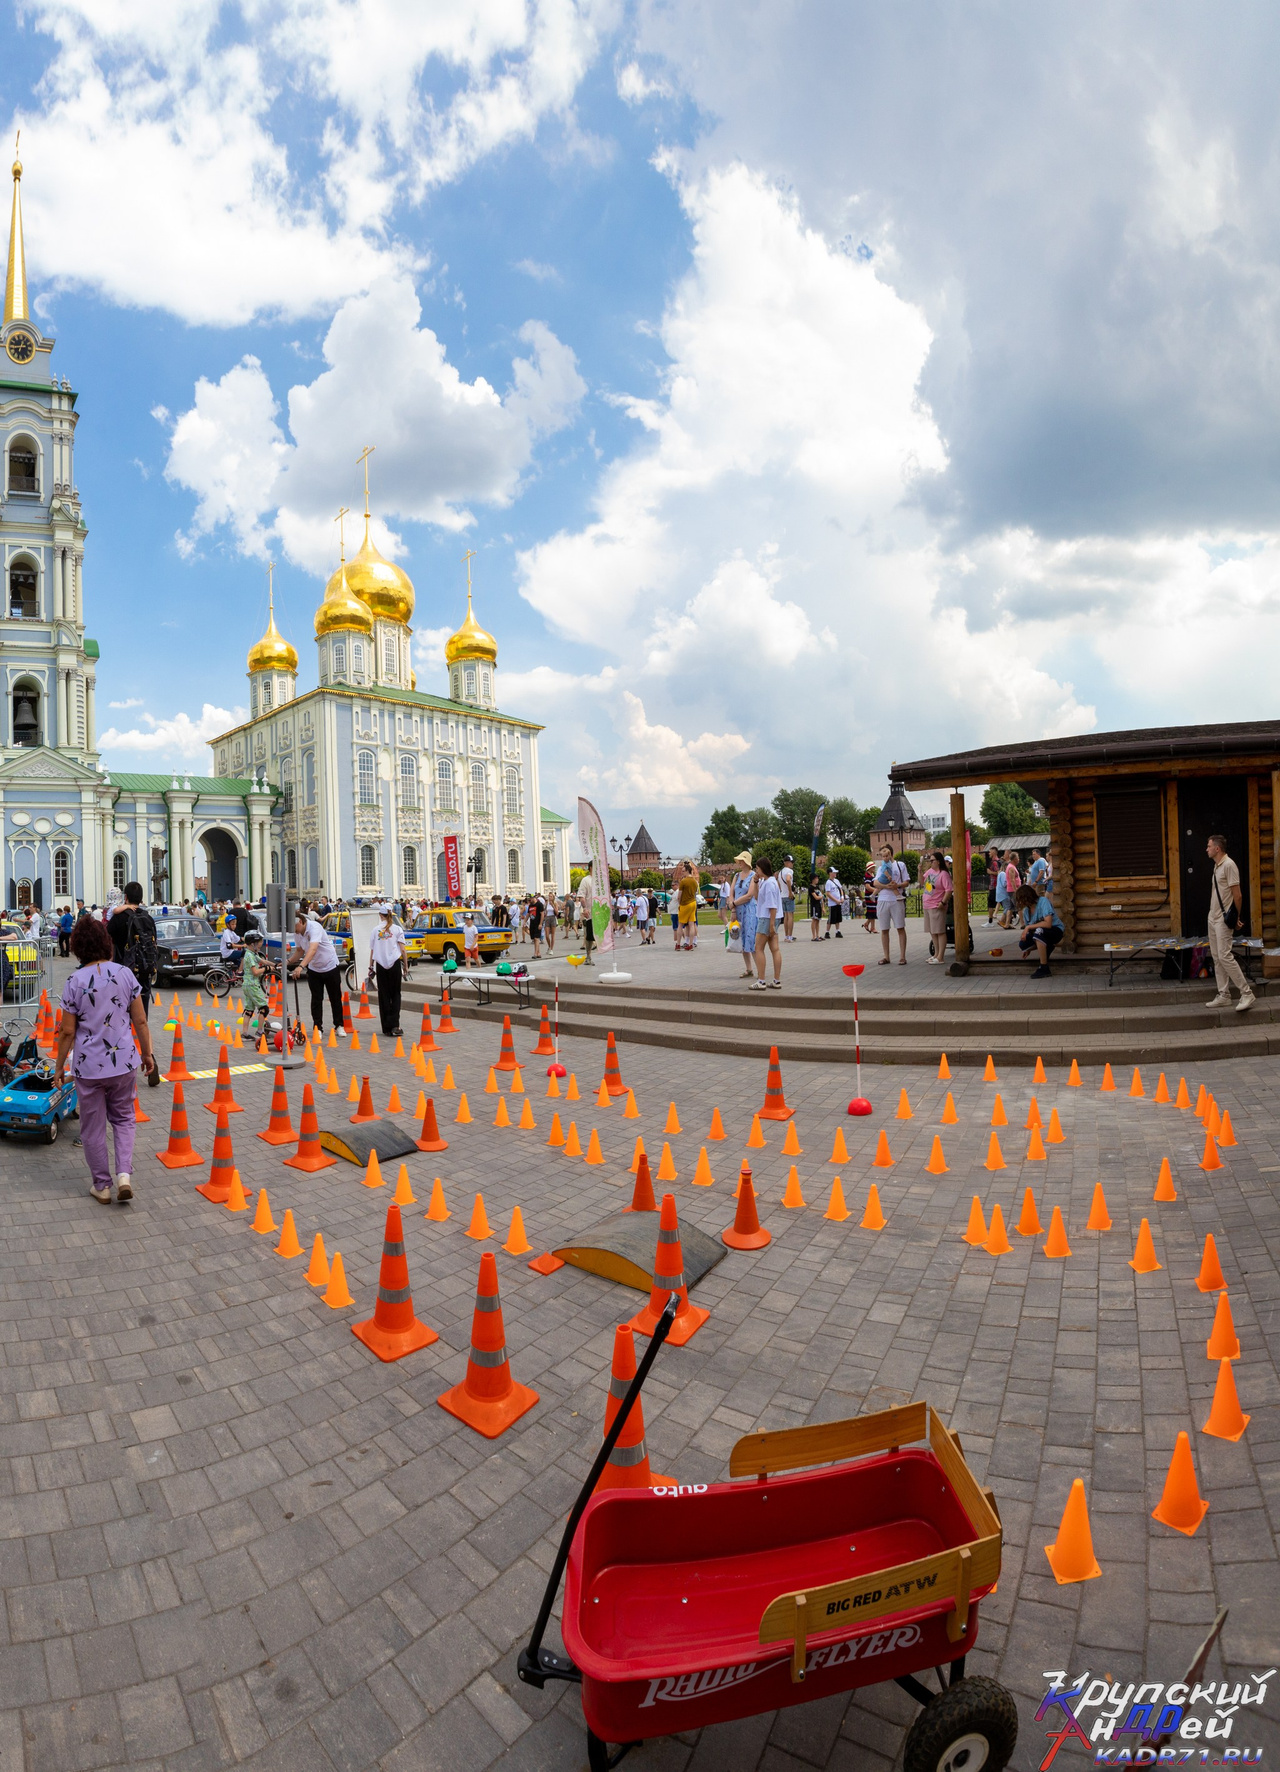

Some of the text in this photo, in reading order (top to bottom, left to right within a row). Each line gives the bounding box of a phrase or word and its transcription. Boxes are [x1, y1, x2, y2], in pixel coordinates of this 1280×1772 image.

[446, 843, 459, 891] auto.ru
[826, 1573, 938, 1615] BIG RED ATW
[805, 1624, 921, 1671] FLYER
